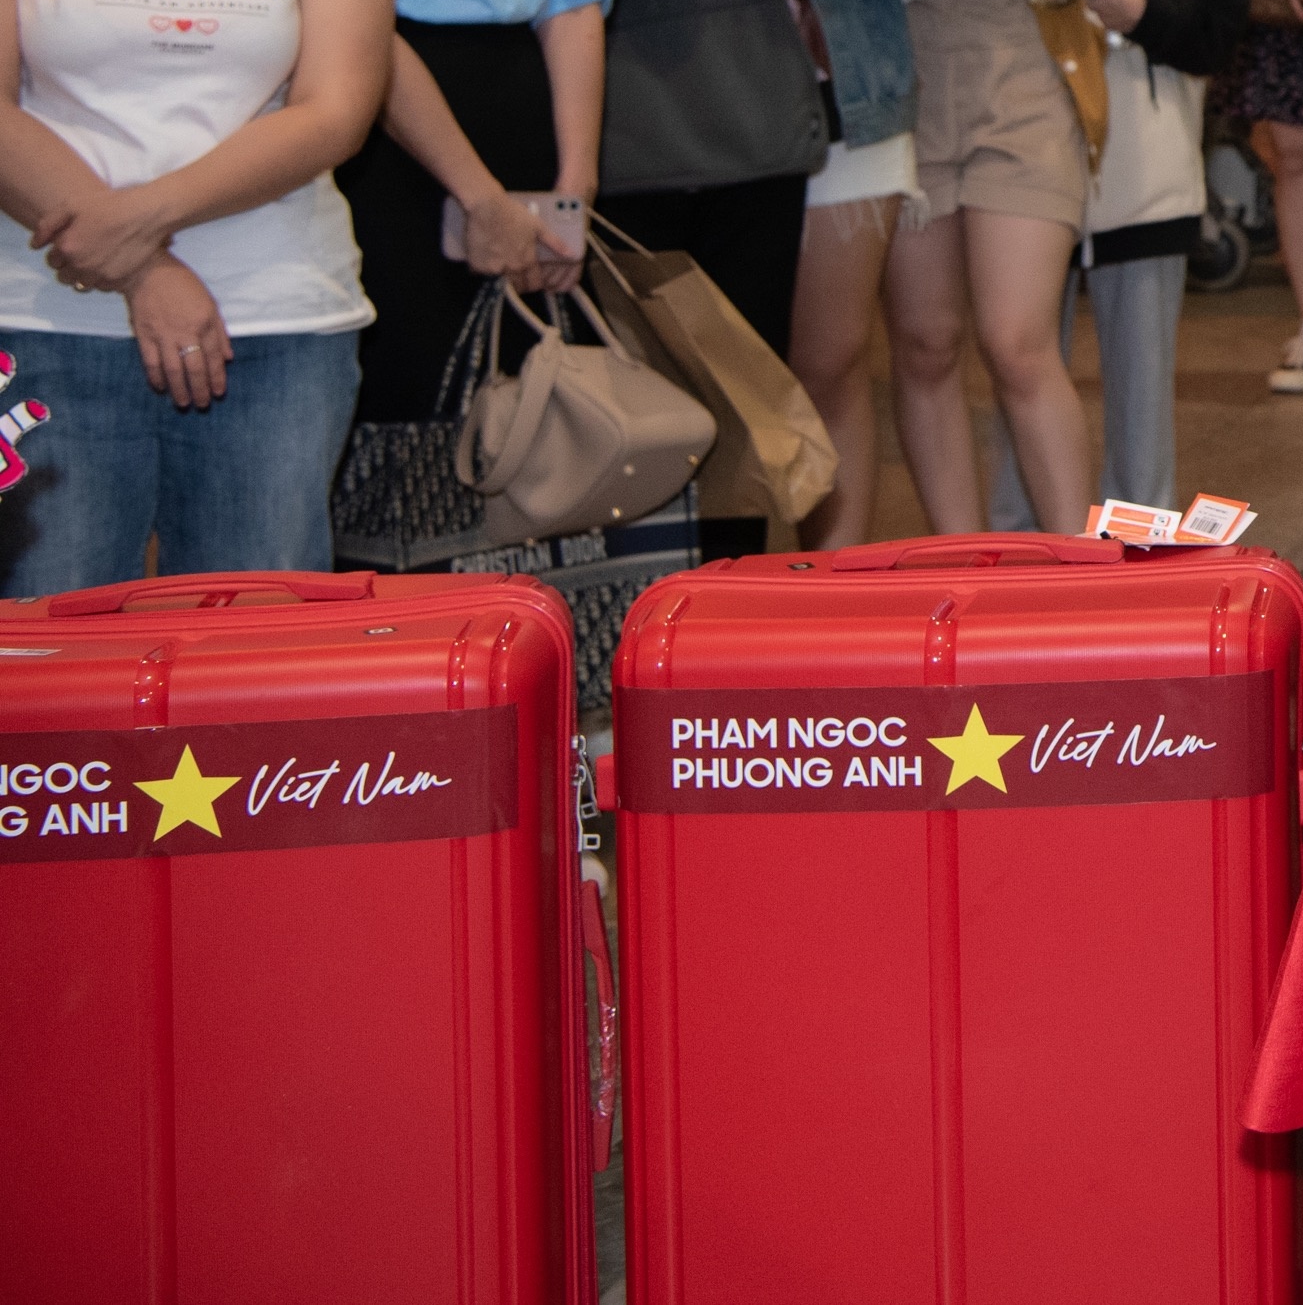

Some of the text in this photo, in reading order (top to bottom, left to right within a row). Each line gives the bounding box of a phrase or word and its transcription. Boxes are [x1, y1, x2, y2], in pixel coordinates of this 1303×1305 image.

[672, 716, 908, 749] PHAM NGOC
[1030, 714, 1217, 773] Viet Nam
[247, 751, 453, 816] Viet Nam
[672, 755, 922, 788] PHUONG ANH
[39, 800, 128, 836] ANH
